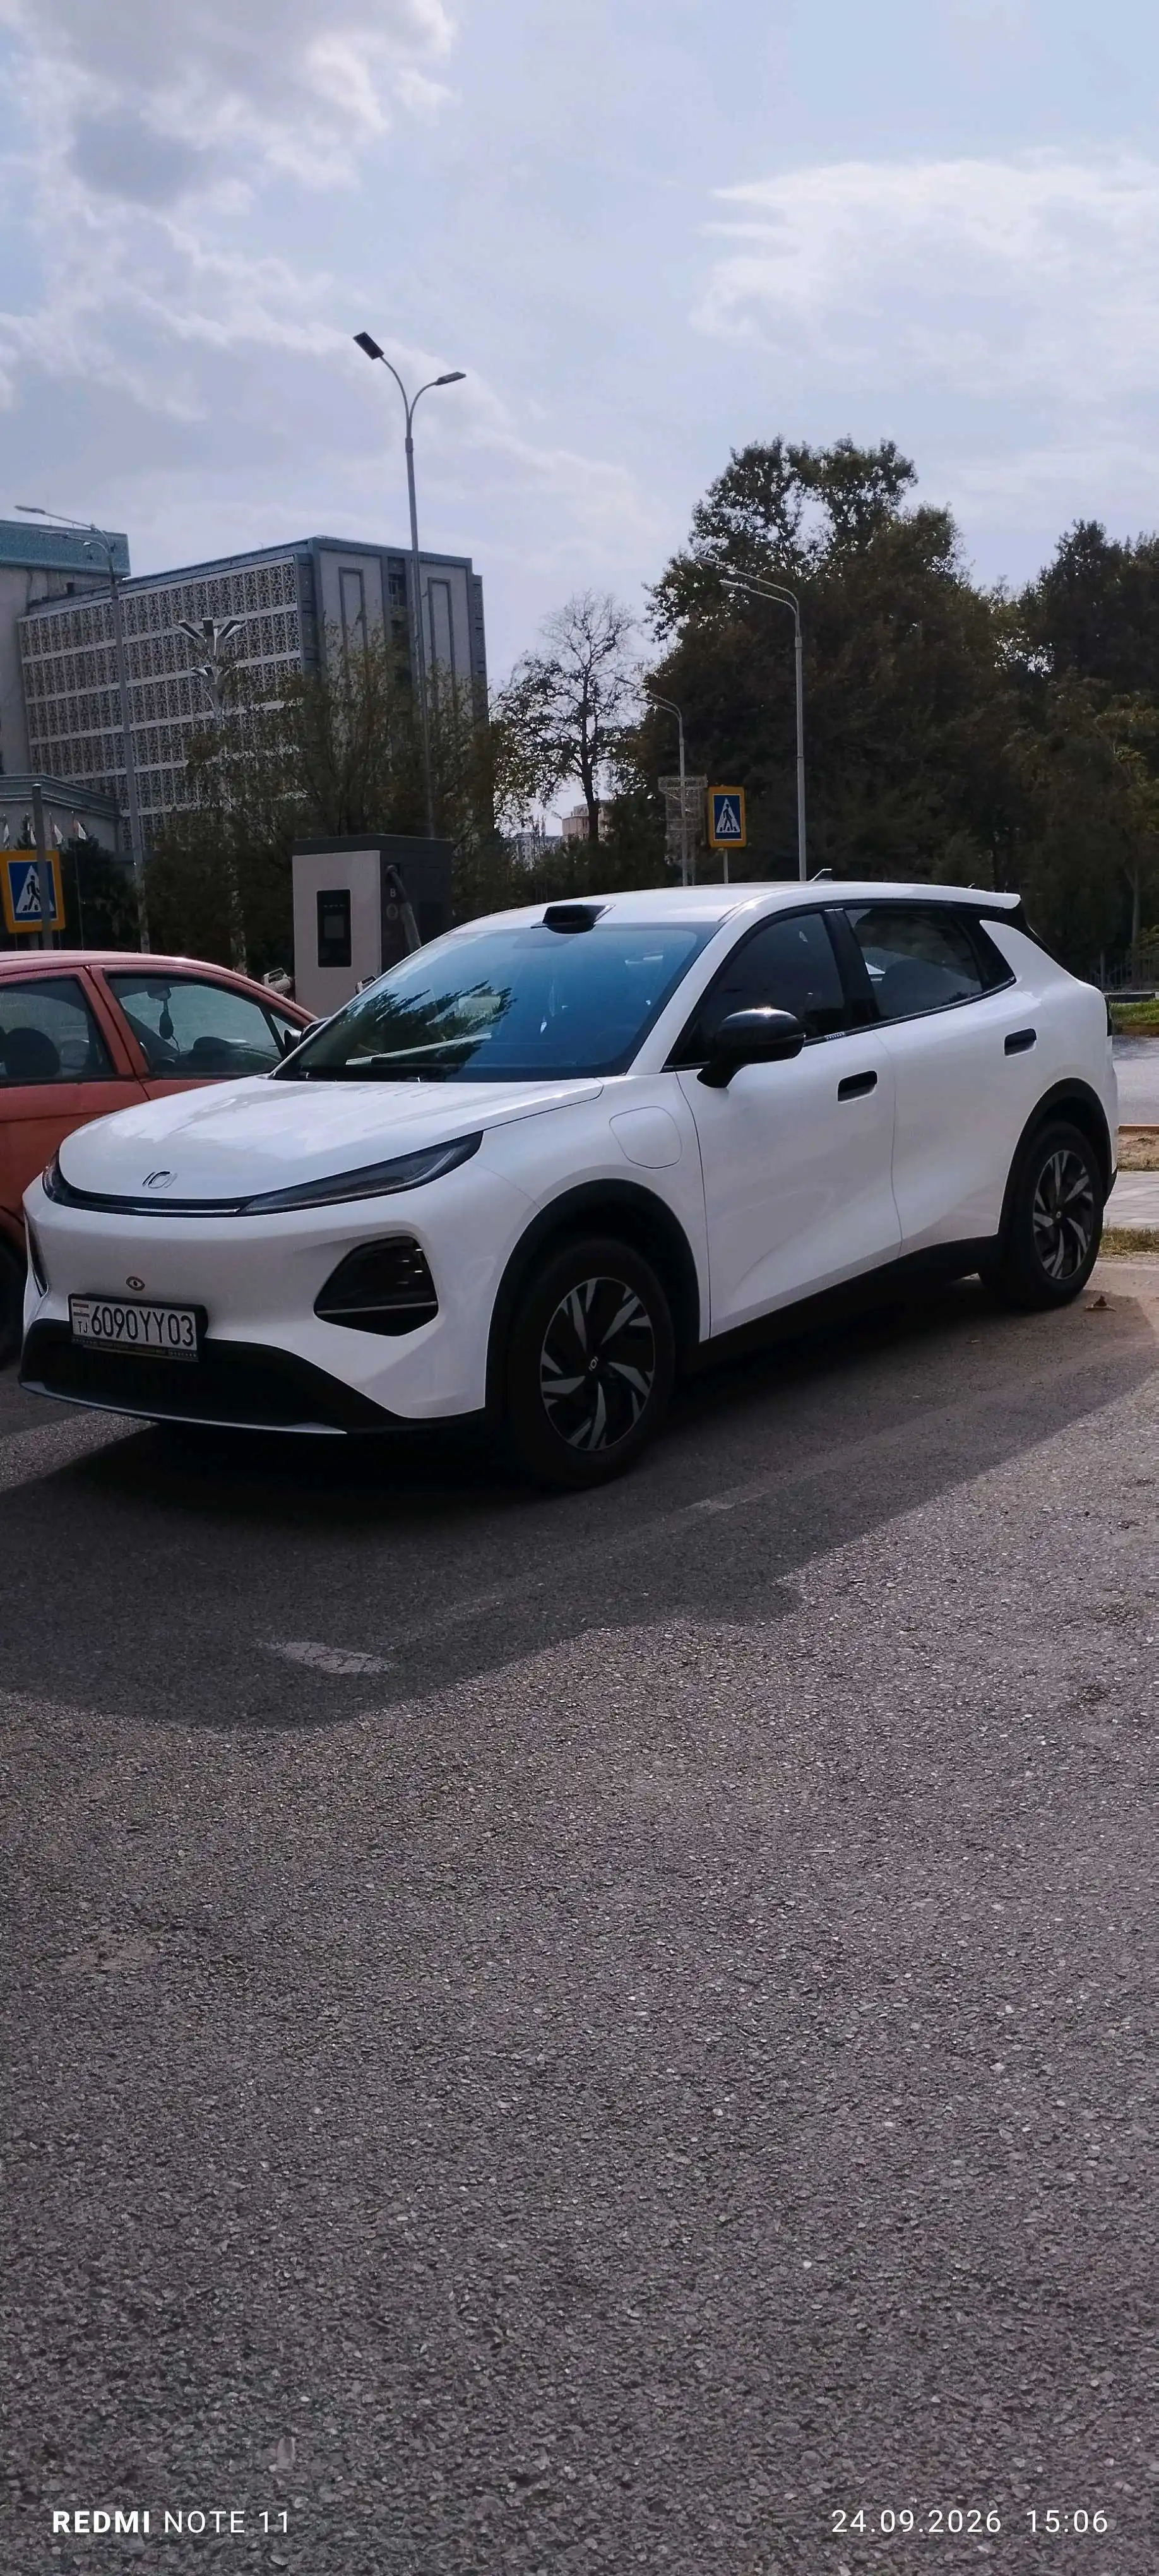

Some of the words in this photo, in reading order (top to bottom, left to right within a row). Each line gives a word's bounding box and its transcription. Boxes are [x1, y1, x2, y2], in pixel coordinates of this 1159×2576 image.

[390, 888, 396, 897] B
[78, 1321, 88, 1333] TJ
[91, 1306, 193, 1346] 6090YY03
